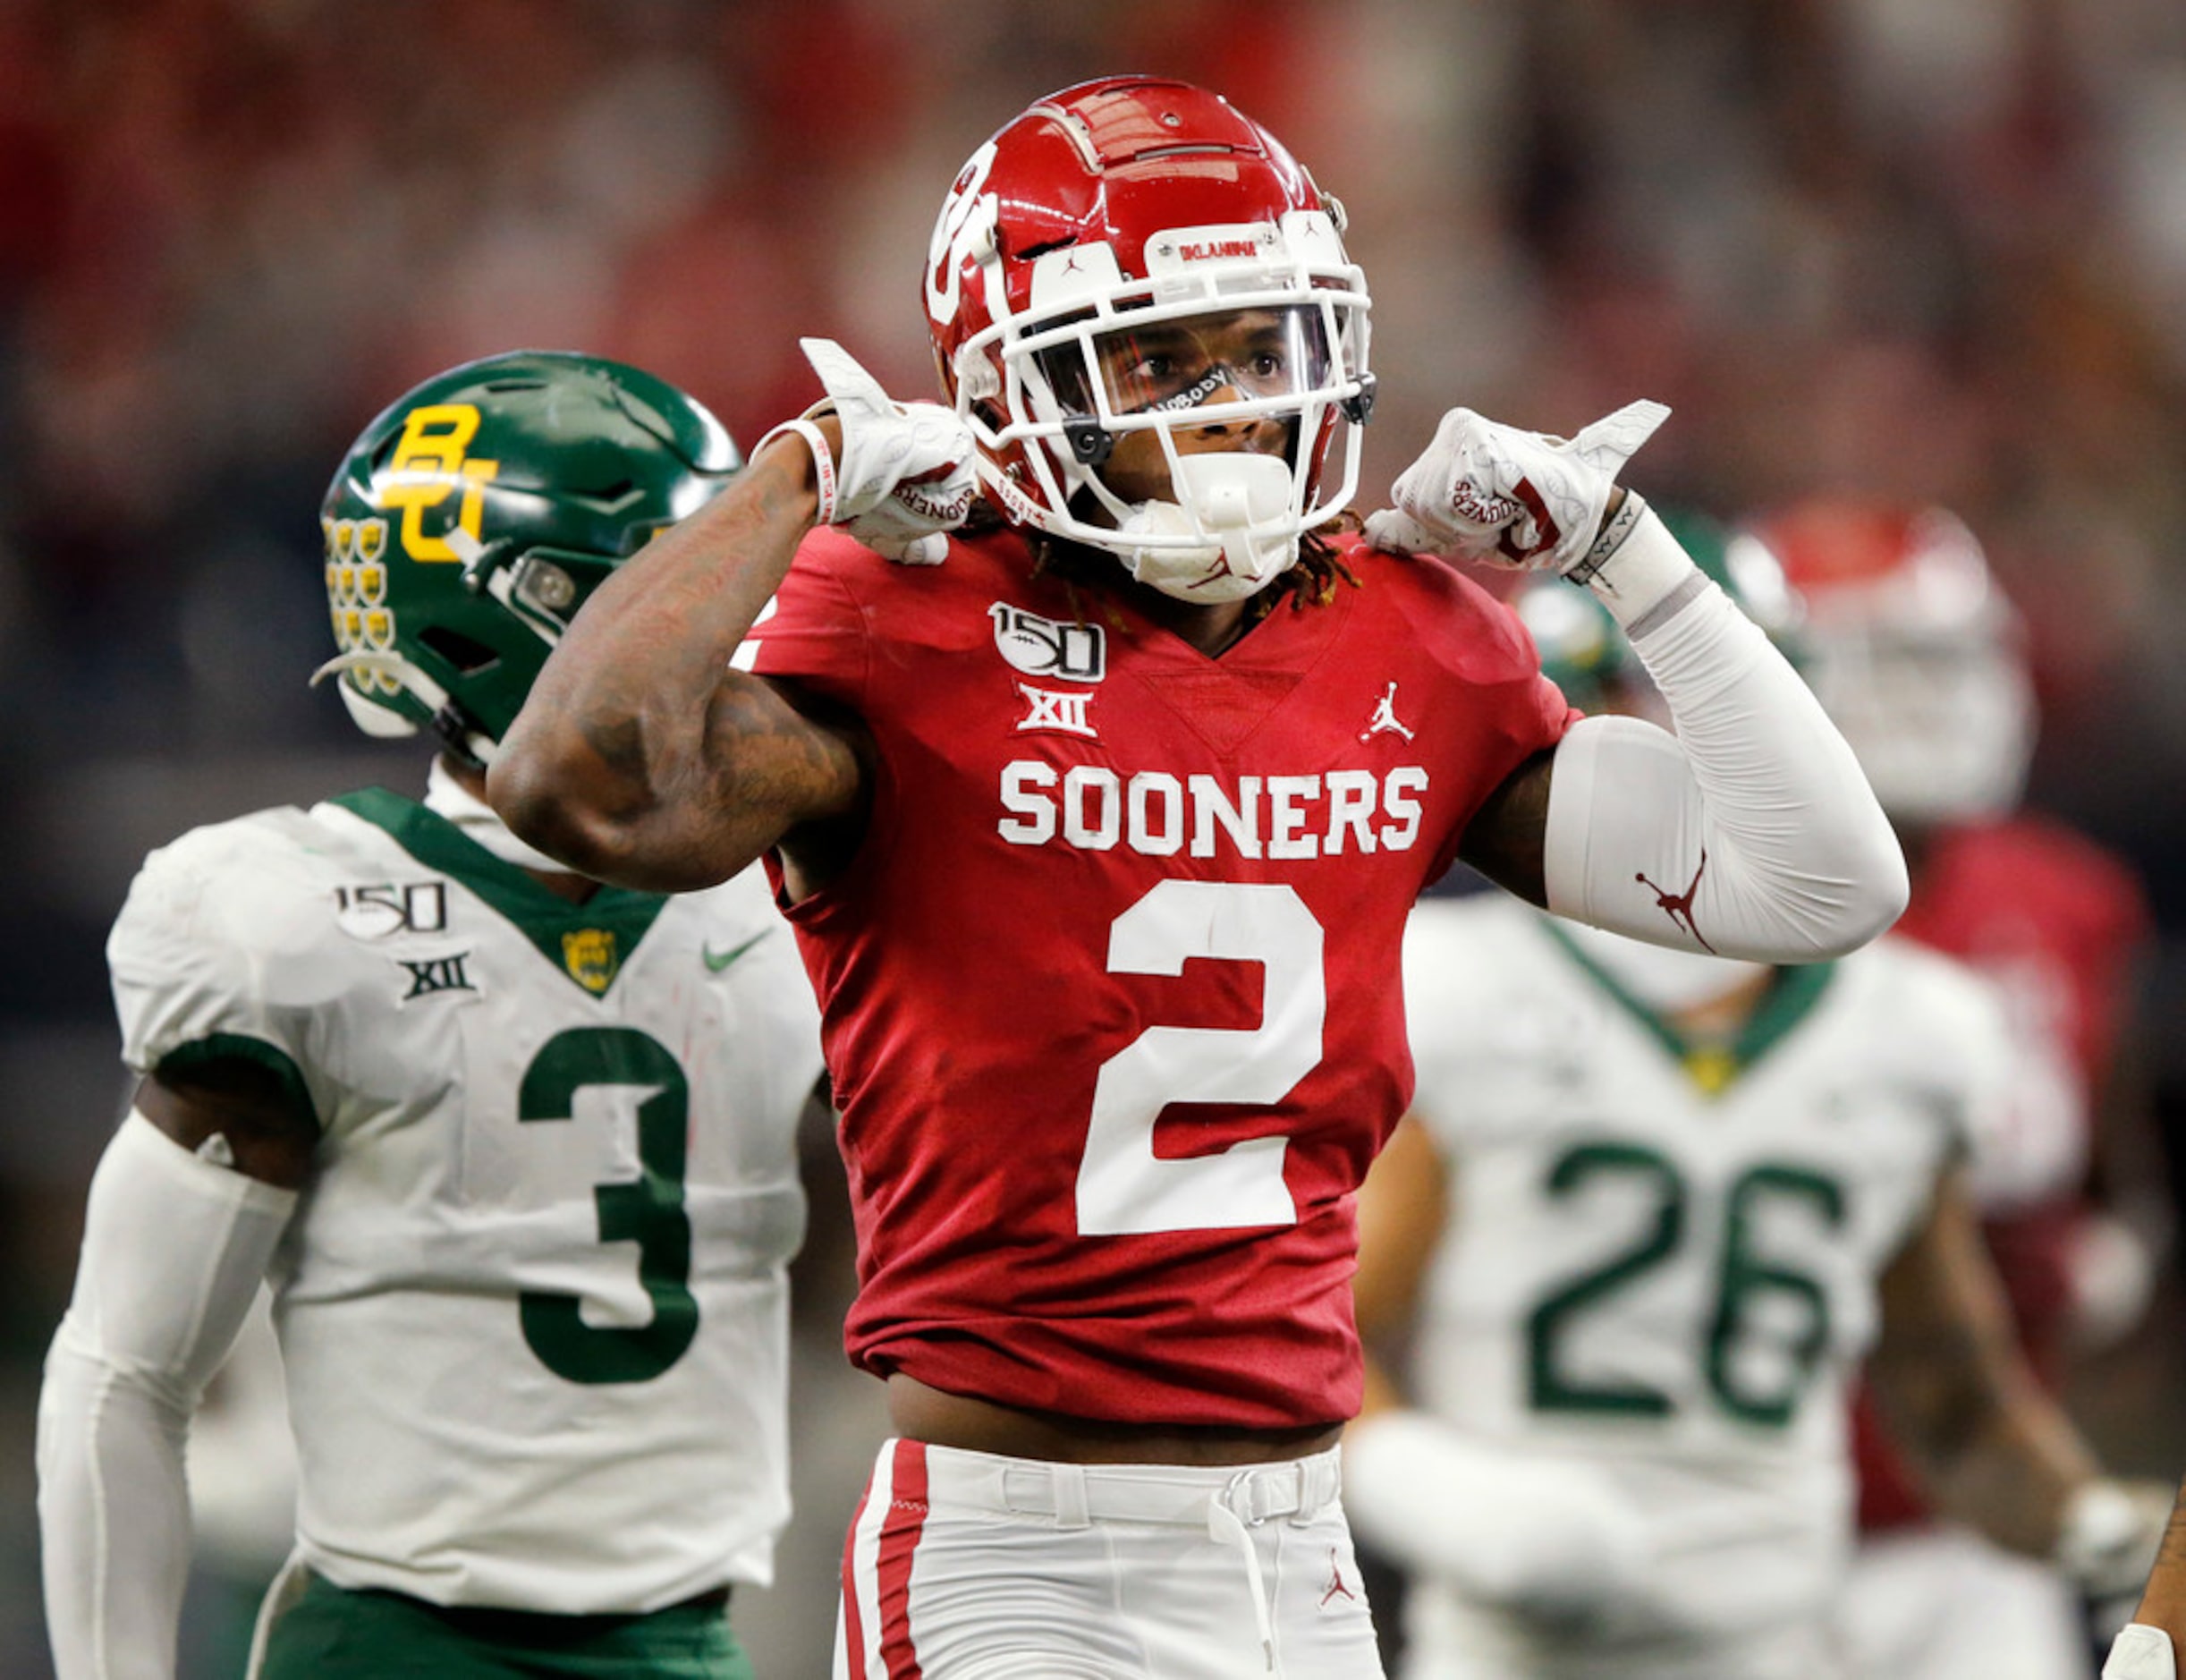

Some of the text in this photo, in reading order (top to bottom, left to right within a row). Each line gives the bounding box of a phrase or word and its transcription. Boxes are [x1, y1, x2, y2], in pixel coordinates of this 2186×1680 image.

[991, 604, 1104, 680] 150
[1016, 682, 1098, 738] XII
[997, 759, 1428, 860] SOONERS
[335, 881, 446, 934] 150
[398, 951, 478, 1001] XII
[1074, 878, 1327, 1236] 2
[518, 1026, 699, 1386] 3
[1527, 1140, 1845, 1430] 26
